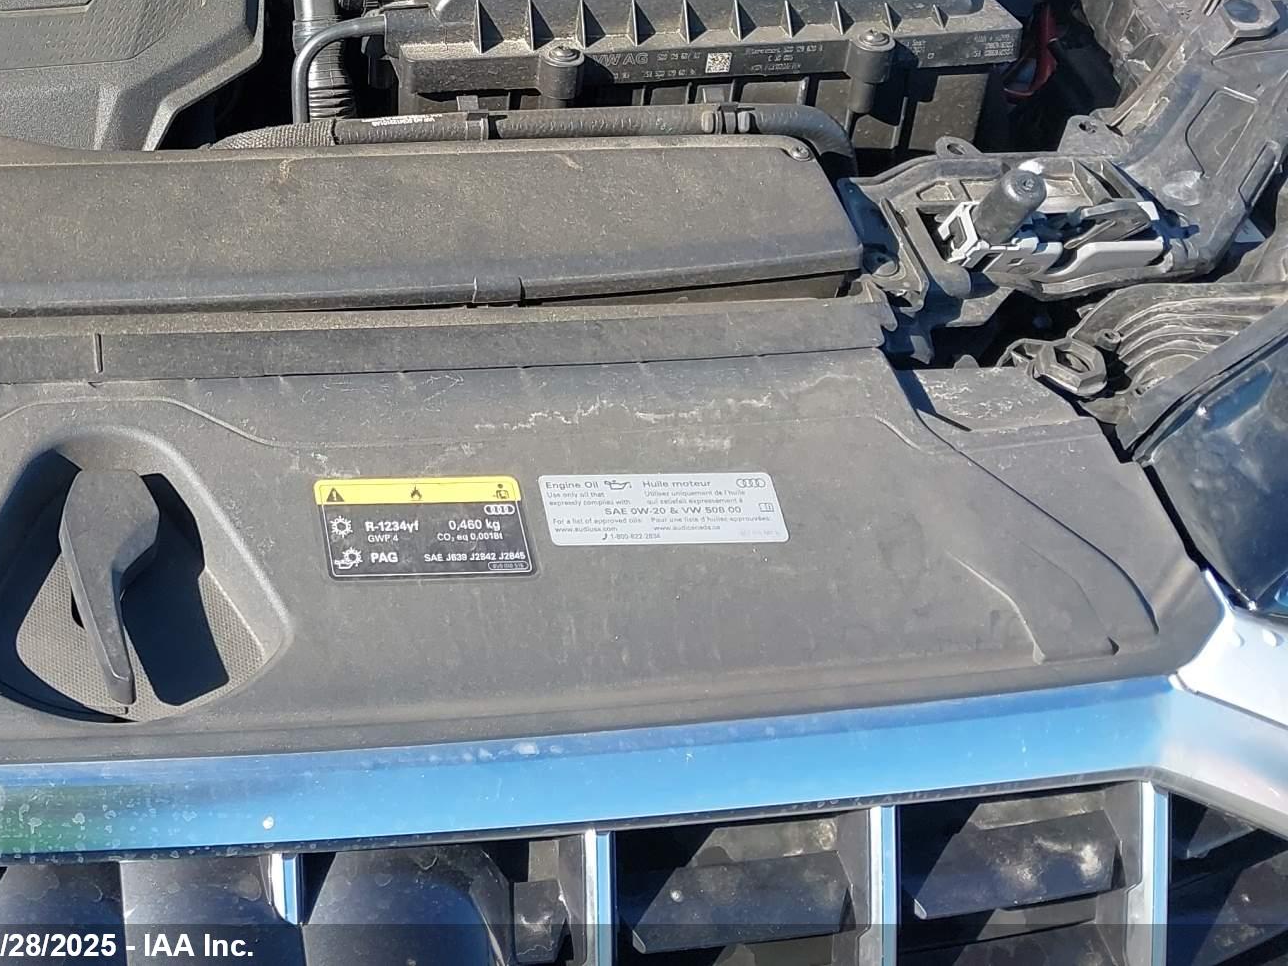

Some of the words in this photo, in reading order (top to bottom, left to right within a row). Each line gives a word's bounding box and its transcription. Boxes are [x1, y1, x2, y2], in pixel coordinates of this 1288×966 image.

[593, 54, 620, 67] VW
[624, 53, 649, 65] AG
[545, 481, 581, 490] Engine
[584, 481, 599, 489] Oil
[642, 480, 669, 488] Huile
[671, 490, 713, 498] uniquement
[549, 499, 582, 507] expressly
[604, 507, 628, 515] SAE
[631, 507, 666, 515] 0W-20
[681, 506, 702, 514] VW
[705, 506, 725, 514] 508
[728, 506, 742, 514] 00
[594, 517, 627, 525] approved
[365, 521, 419, 533] R-1234yf
[448, 520, 482, 531] 0,460
[485, 519, 501, 531] kg
[456, 533, 468, 542] eq
[370, 552, 398, 563] PAG
[424, 554, 444, 562] SAE
[446, 553, 467, 561] J639
[470, 552, 497, 561] J2842
[499, 551, 526, 560] J2845
